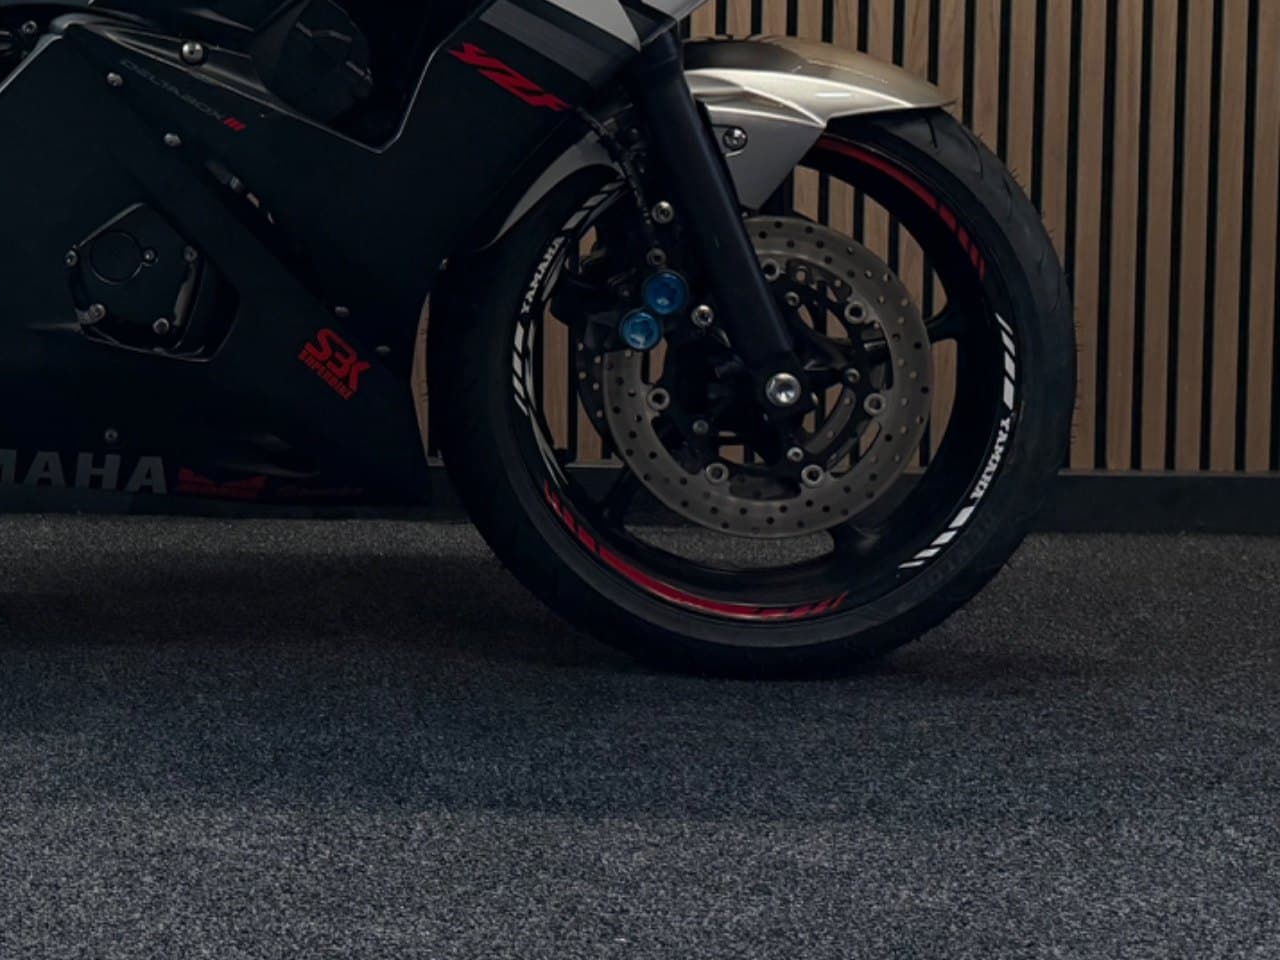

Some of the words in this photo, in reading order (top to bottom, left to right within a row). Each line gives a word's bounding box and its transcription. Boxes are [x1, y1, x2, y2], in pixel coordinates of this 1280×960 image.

[520, 235, 567, 315] YAMAHA
[302, 327, 371, 394] SBK
[969, 415, 1012, 501] YAMAHA
